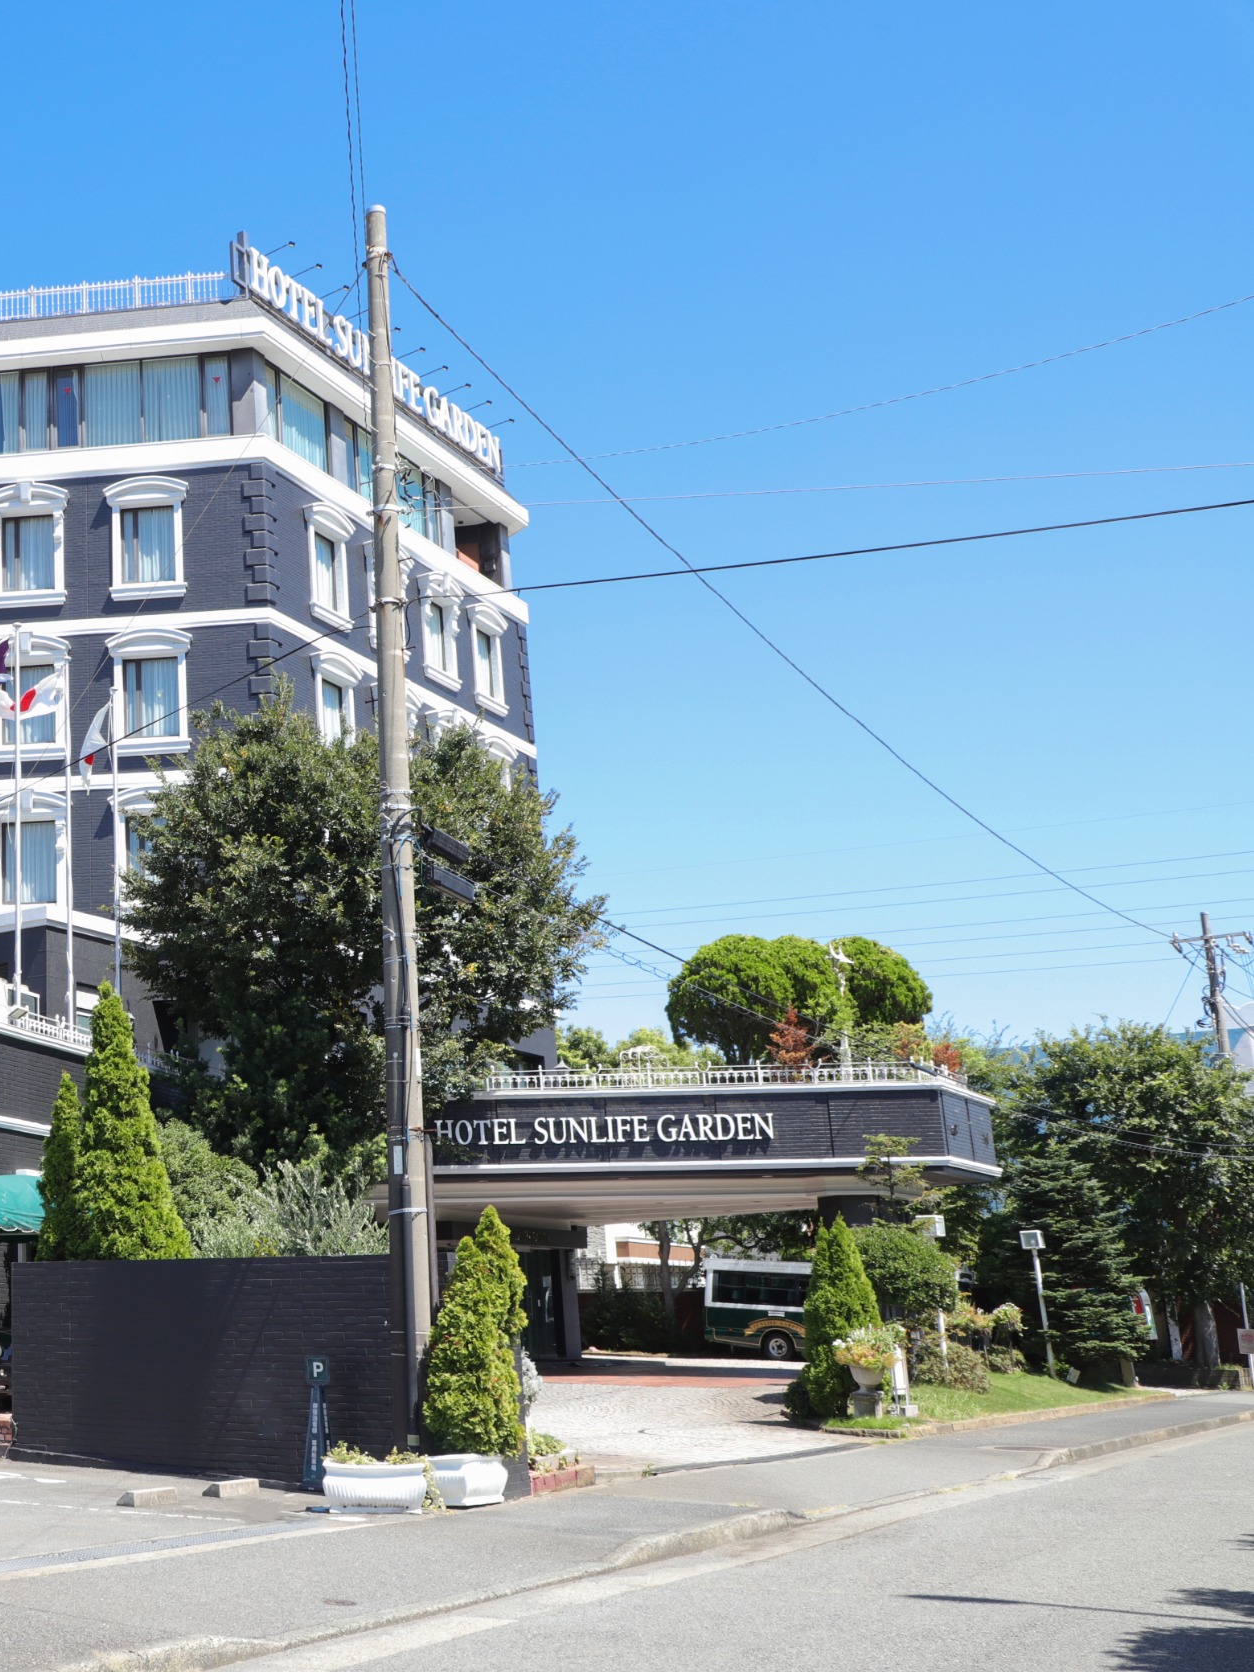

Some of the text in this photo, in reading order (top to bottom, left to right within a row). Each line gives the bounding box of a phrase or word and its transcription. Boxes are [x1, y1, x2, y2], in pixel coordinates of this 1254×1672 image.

[249, 246, 332, 346] HOTEL
[423, 386, 501, 473] GARDEN
[434, 1113, 774, 1145] HOTEL SUNLIFE GARDEN
[313, 1361, 324, 1378] P
